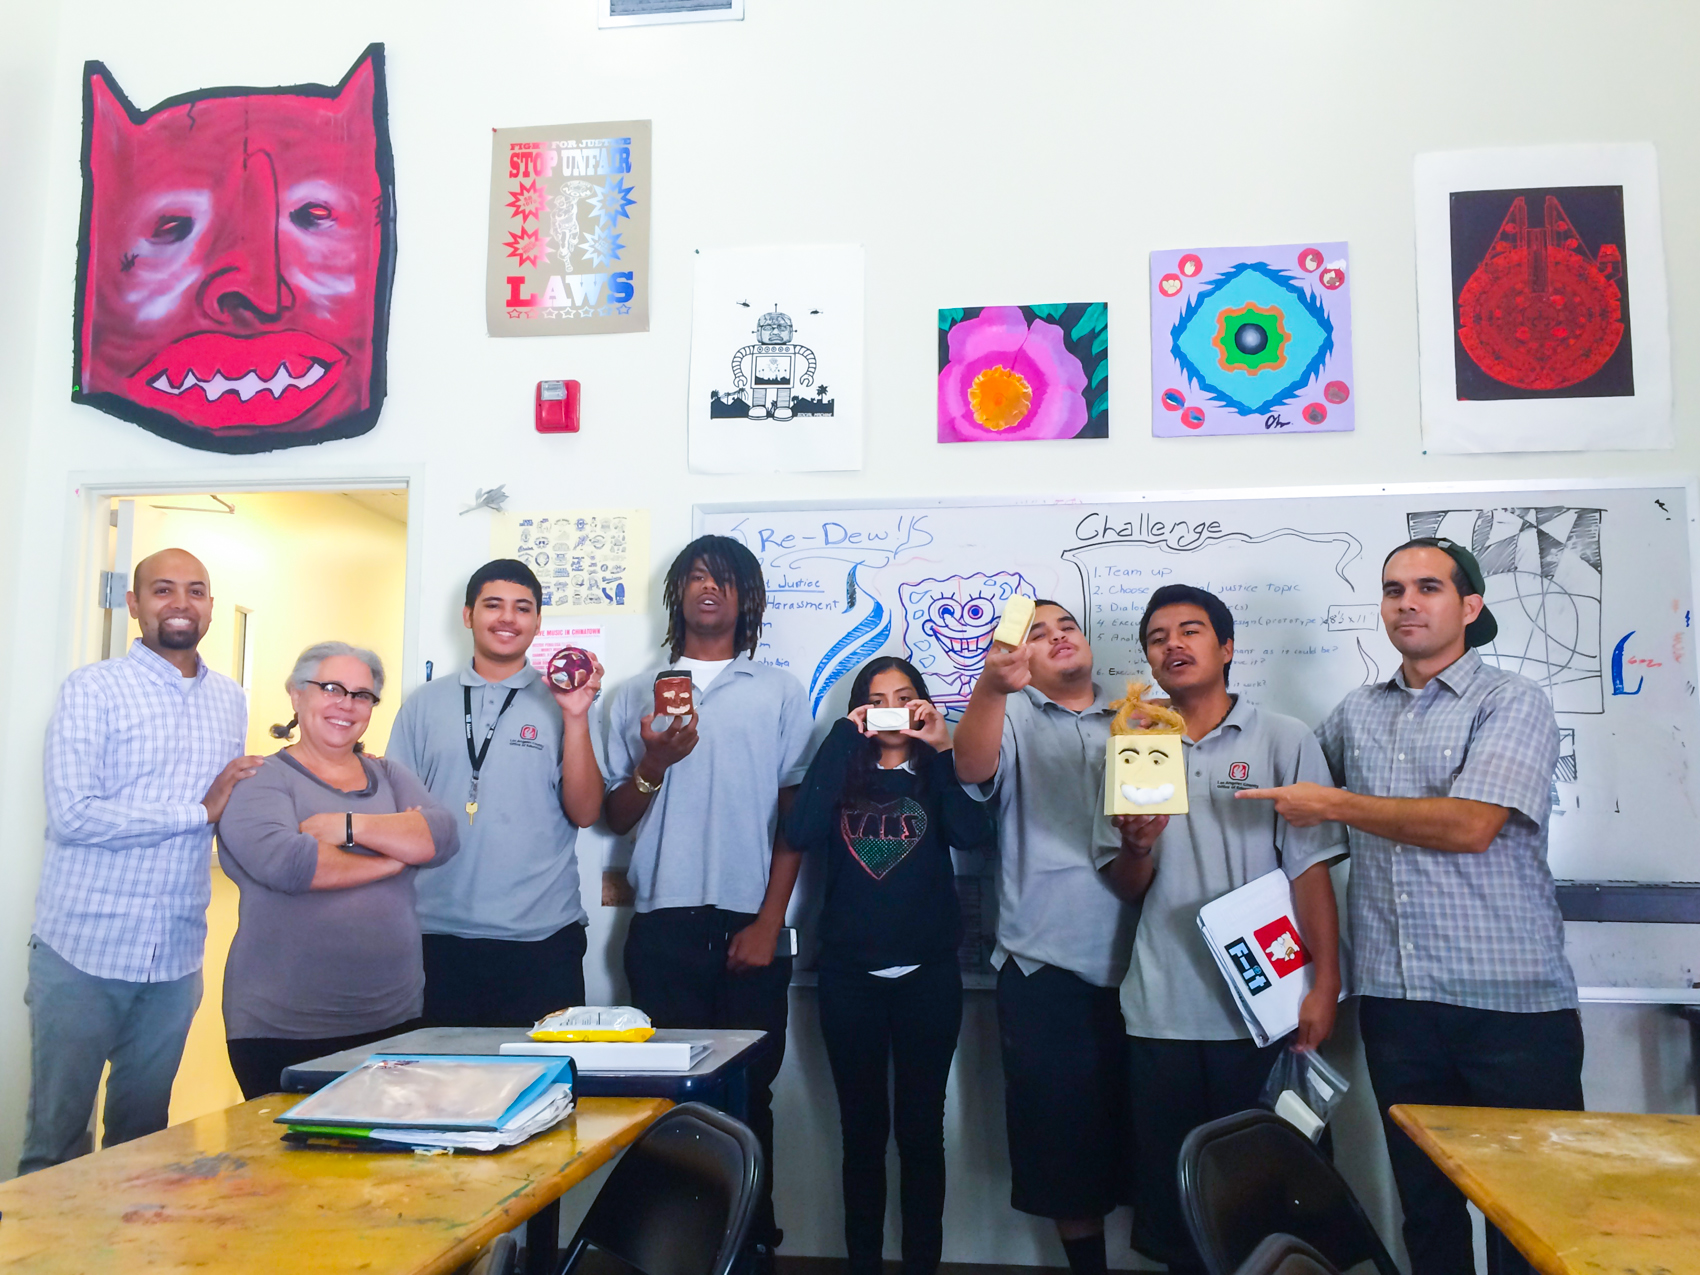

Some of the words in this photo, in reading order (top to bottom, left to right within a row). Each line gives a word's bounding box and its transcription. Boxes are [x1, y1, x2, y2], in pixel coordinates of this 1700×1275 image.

[510, 141, 549, 151] FIGHT
[551, 140, 577, 149] FOR
[579, 137, 632, 147] JUSTICE
[509, 150, 558, 178] STOP
[561, 147, 632, 176] UNFAIR
[562, 186, 592, 197] NOW
[506, 271, 635, 308] LAWS
[1076, 512, 1222, 547] Challenge
[1105, 565, 1142, 577] Team
[1151, 567, 1173, 578] up
[778, 574, 821, 588] Justice
[1093, 585, 1103, 595] 2.
[1108, 584, 1150, 594] Choose
[1218, 583, 1258, 593] justice
[766, 595, 840, 610] Harassment
[1110, 602, 1145, 614] Dialog
[1111, 619, 1142, 627] Execu
[1233, 619, 1257, 627] esign
[1110, 633, 1141, 645] Analy
[1294, 645, 1317, 655] could
